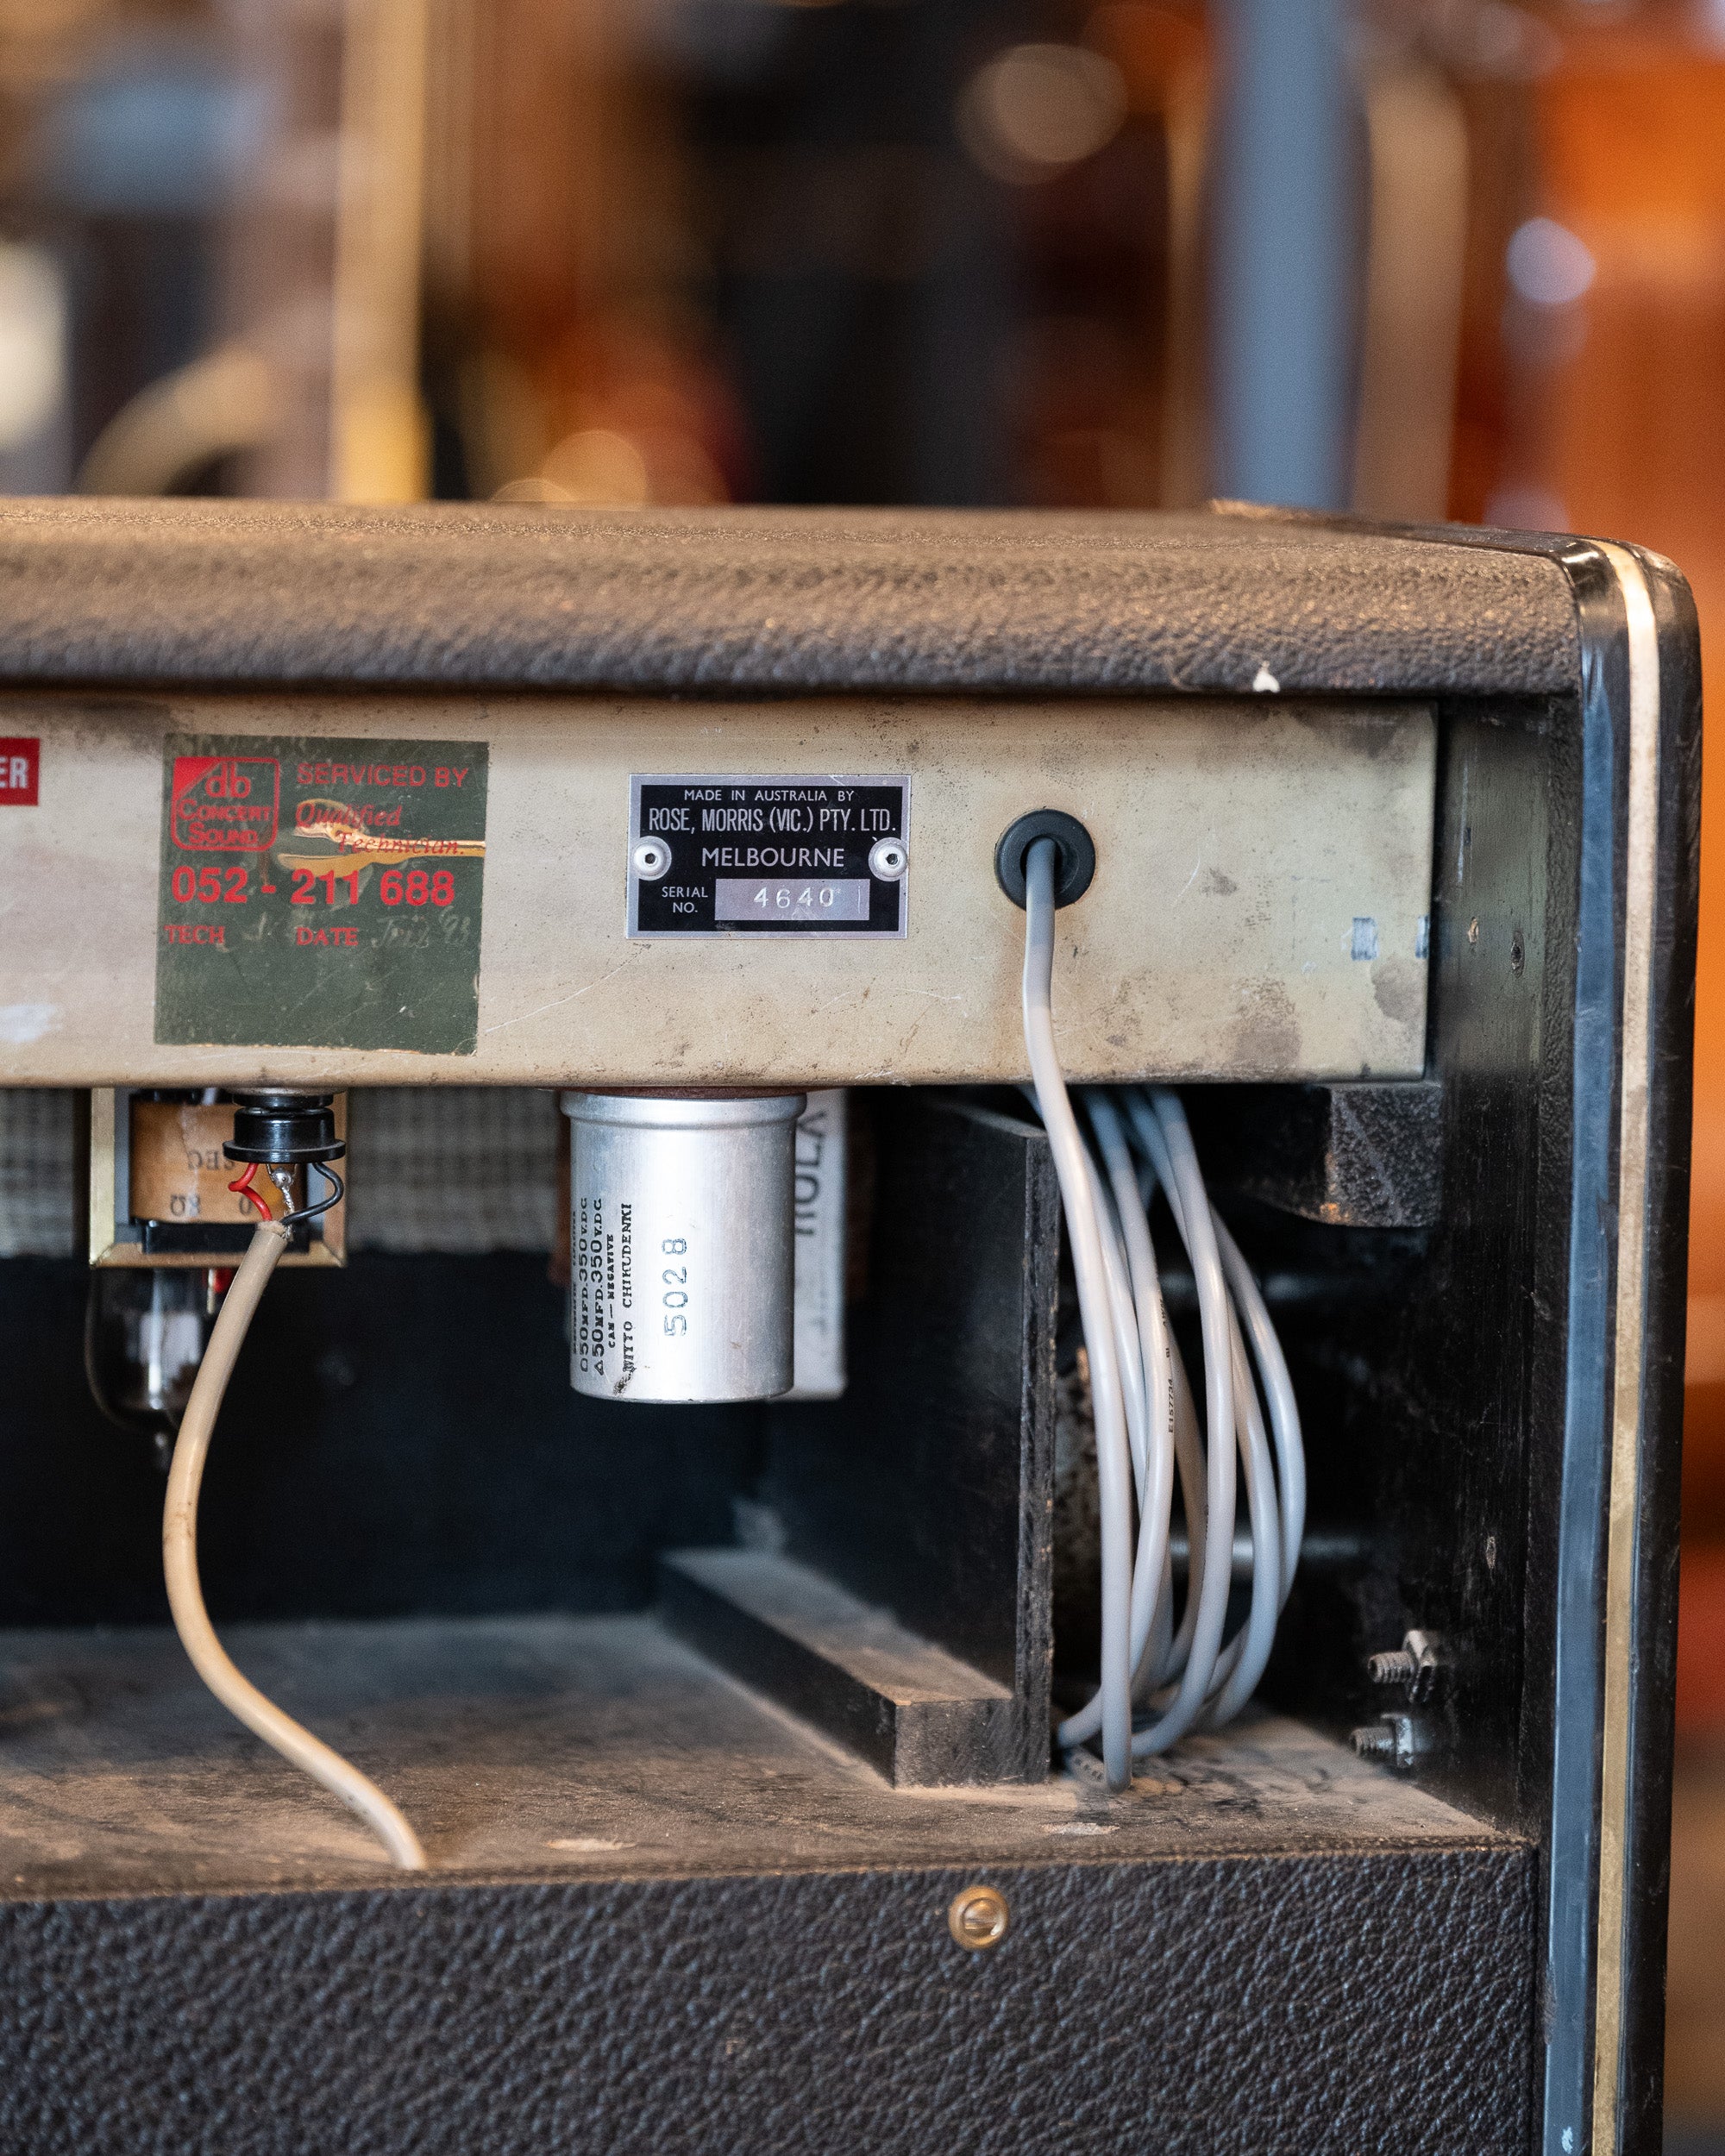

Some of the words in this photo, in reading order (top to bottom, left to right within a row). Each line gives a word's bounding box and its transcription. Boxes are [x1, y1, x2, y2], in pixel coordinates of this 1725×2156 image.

[204, 761, 252, 799] db
[296, 762, 427, 787] SERVICED
[434, 766, 469, 787] BY
[684, 789, 723, 801] MADE
[731, 789, 745, 801] IN
[755, 789, 828, 802] AUSTRALIA
[837, 790, 855, 802] BY
[294, 802, 403, 830] Qualified
[649, 807, 695, 835] ROSE,
[701, 807, 763, 832] MORRIS
[769, 806, 813, 834] (VIC.)
[819, 808, 856, 832] PTY.
[860, 808, 897, 832] LTD.
[701, 848, 845, 868] MELBOURNE
[172, 865, 248, 904] 052
[290, 868, 360, 906] 211
[380, 869, 455, 906] 688
[661, 886, 709, 899] SERIAL
[753, 887, 835, 909] 4640
[672, 902, 699, 914] NO.
[164, 924, 226, 946] TECH
[296, 927, 359, 947] DATE
[606, 1233, 615, 1300] NEGATIVE
[661, 1237, 689, 1337] 5028
[607, 1322, 616, 1349] CAN
